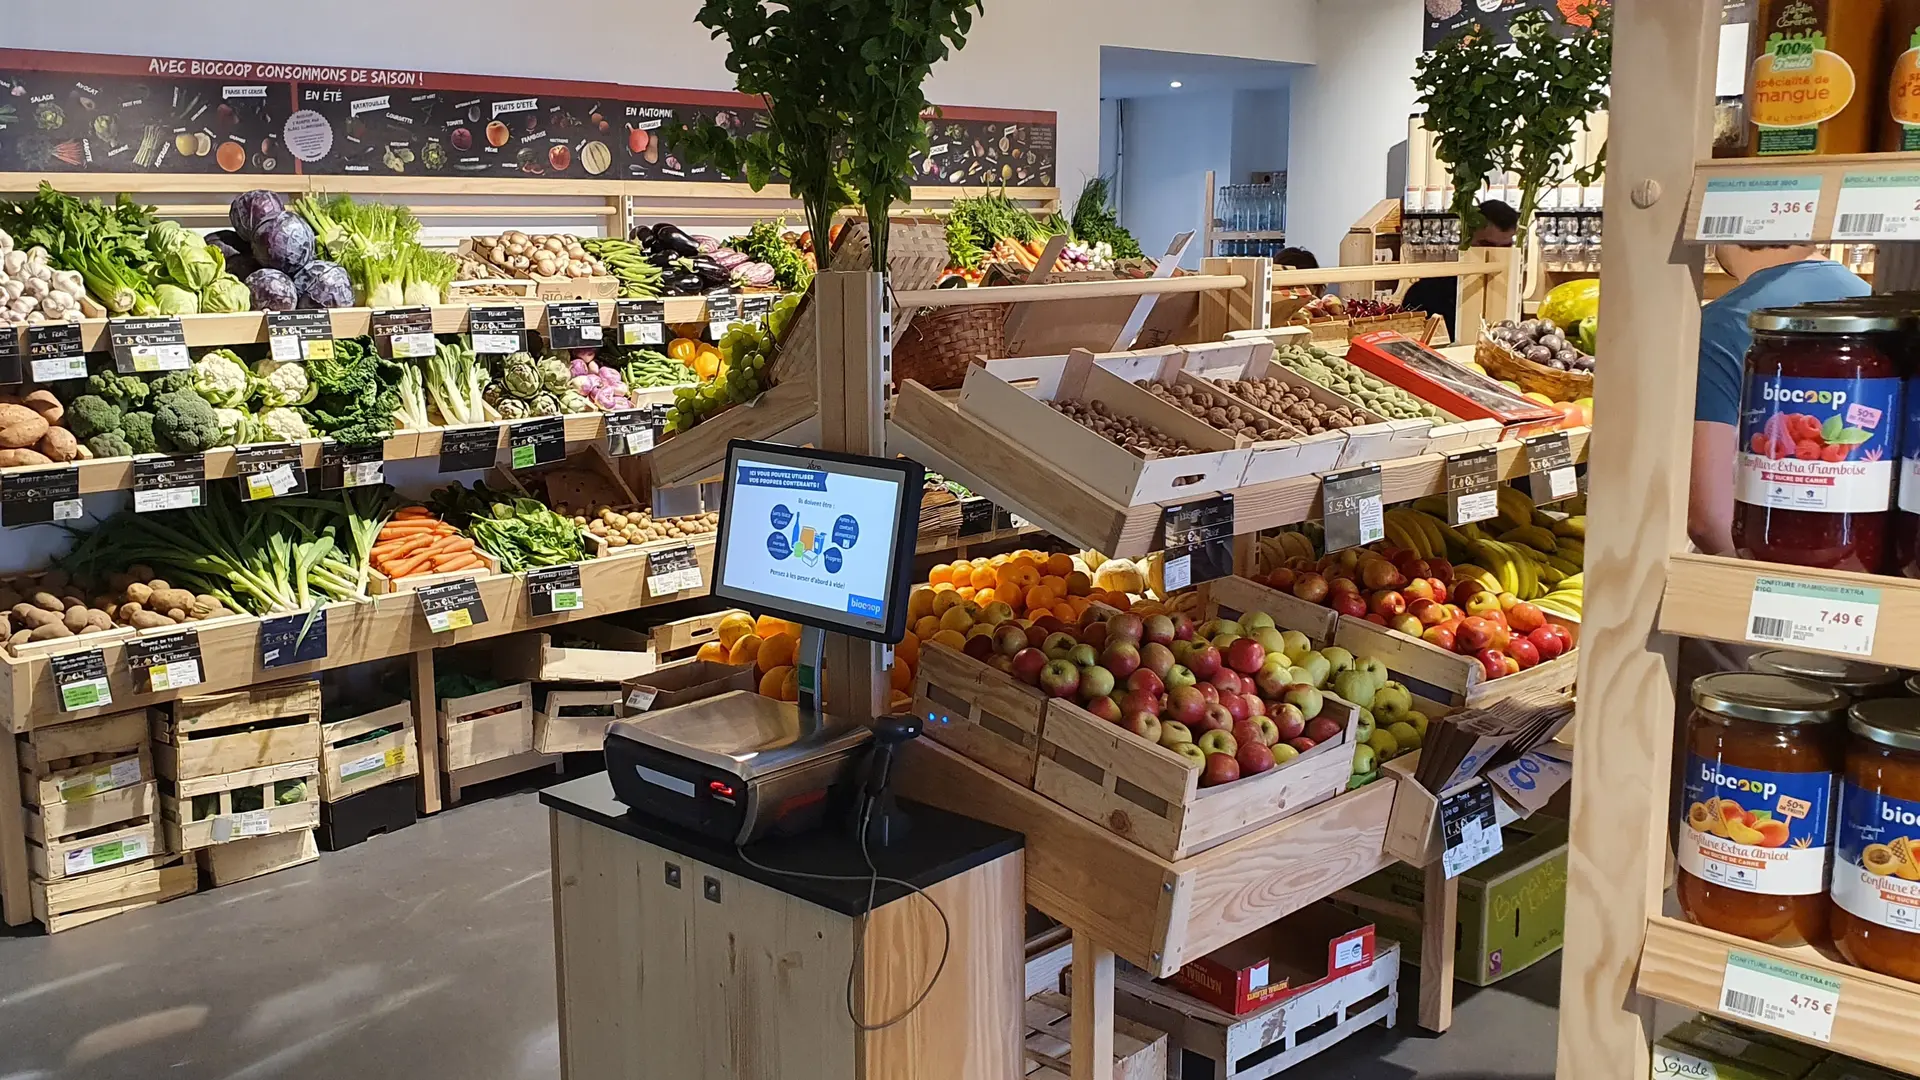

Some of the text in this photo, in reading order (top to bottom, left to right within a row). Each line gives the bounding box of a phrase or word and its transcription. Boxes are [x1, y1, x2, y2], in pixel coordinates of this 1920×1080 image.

[1775, 42, 1812, 56] 100%
[149, 58, 423, 86] AVEC BIOCOOP CONSOMMONS DE SAISON !
[305, 88, 342, 101] EN ÉTÉ
[1756, 88, 1829, 103] mangue
[352, 99, 388, 110] RATATOUILLE
[494, 102, 514, 112] FRUITS
[626, 107, 637, 116] EN
[1770, 202, 1814, 215] 3,36 €
[1763, 382, 1847, 410] biocoop
[1777, 460, 1805, 473] Extra
[1808, 463, 1866, 476] Framboise
[783, 480, 817, 488] CONTENANTS
[804, 499, 821, 507] doivent
[797, 575, 809, 583] peser
[810, 576, 828, 586] d'abord
[1756, 578, 1796, 588] CONFITURE
[1840, 587, 1864, 596] EXTRA
[851, 600, 880, 615] biocoop
[1820, 610, 1864, 626] 7,49 €
[1701, 763, 1777, 801] biocoop
[1786, 799, 1805, 810] 50%
[1788, 806, 1805, 816] FRUITS
[1721, 843, 1748, 857] Extra
[1860, 872, 1908, 893] Confiture
[1730, 954, 1767, 969] CONFITURE
[1769, 965, 1799, 978] ABRICOT
[1800, 973, 1823, 984] EXTRA
[1791, 994, 1833, 1015] 4,75 €
[1654, 1056, 1710, 1077] Sojade
